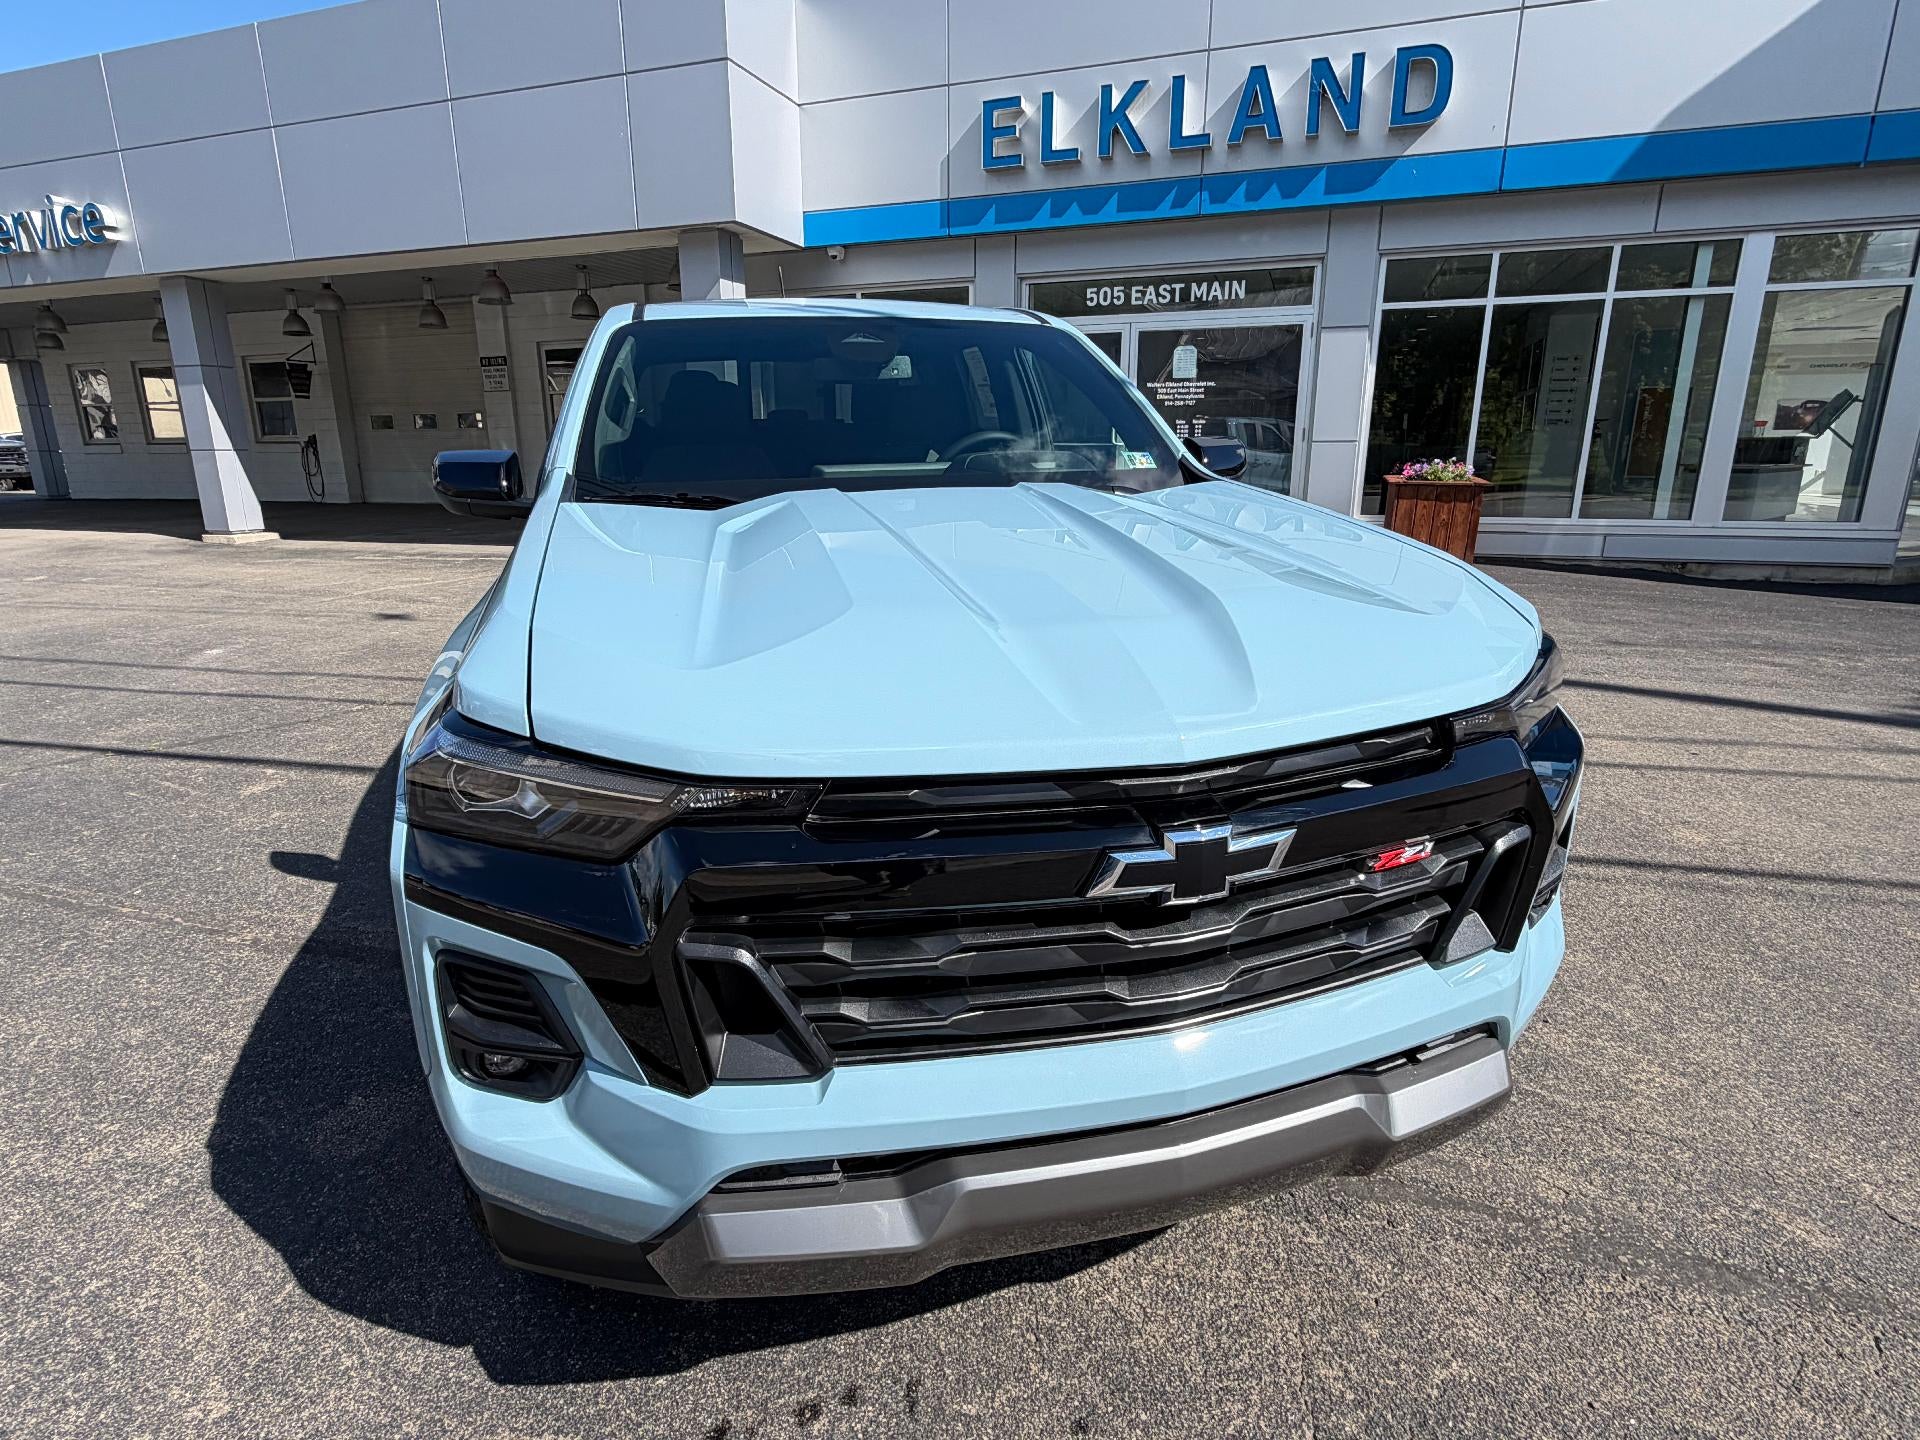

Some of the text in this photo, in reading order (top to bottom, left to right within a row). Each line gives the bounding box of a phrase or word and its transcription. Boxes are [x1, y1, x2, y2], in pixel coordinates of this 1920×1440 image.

[981, 43, 1454, 171] ELKLAND
[1086, 280, 1246, 307] 505 EAST MAIN
